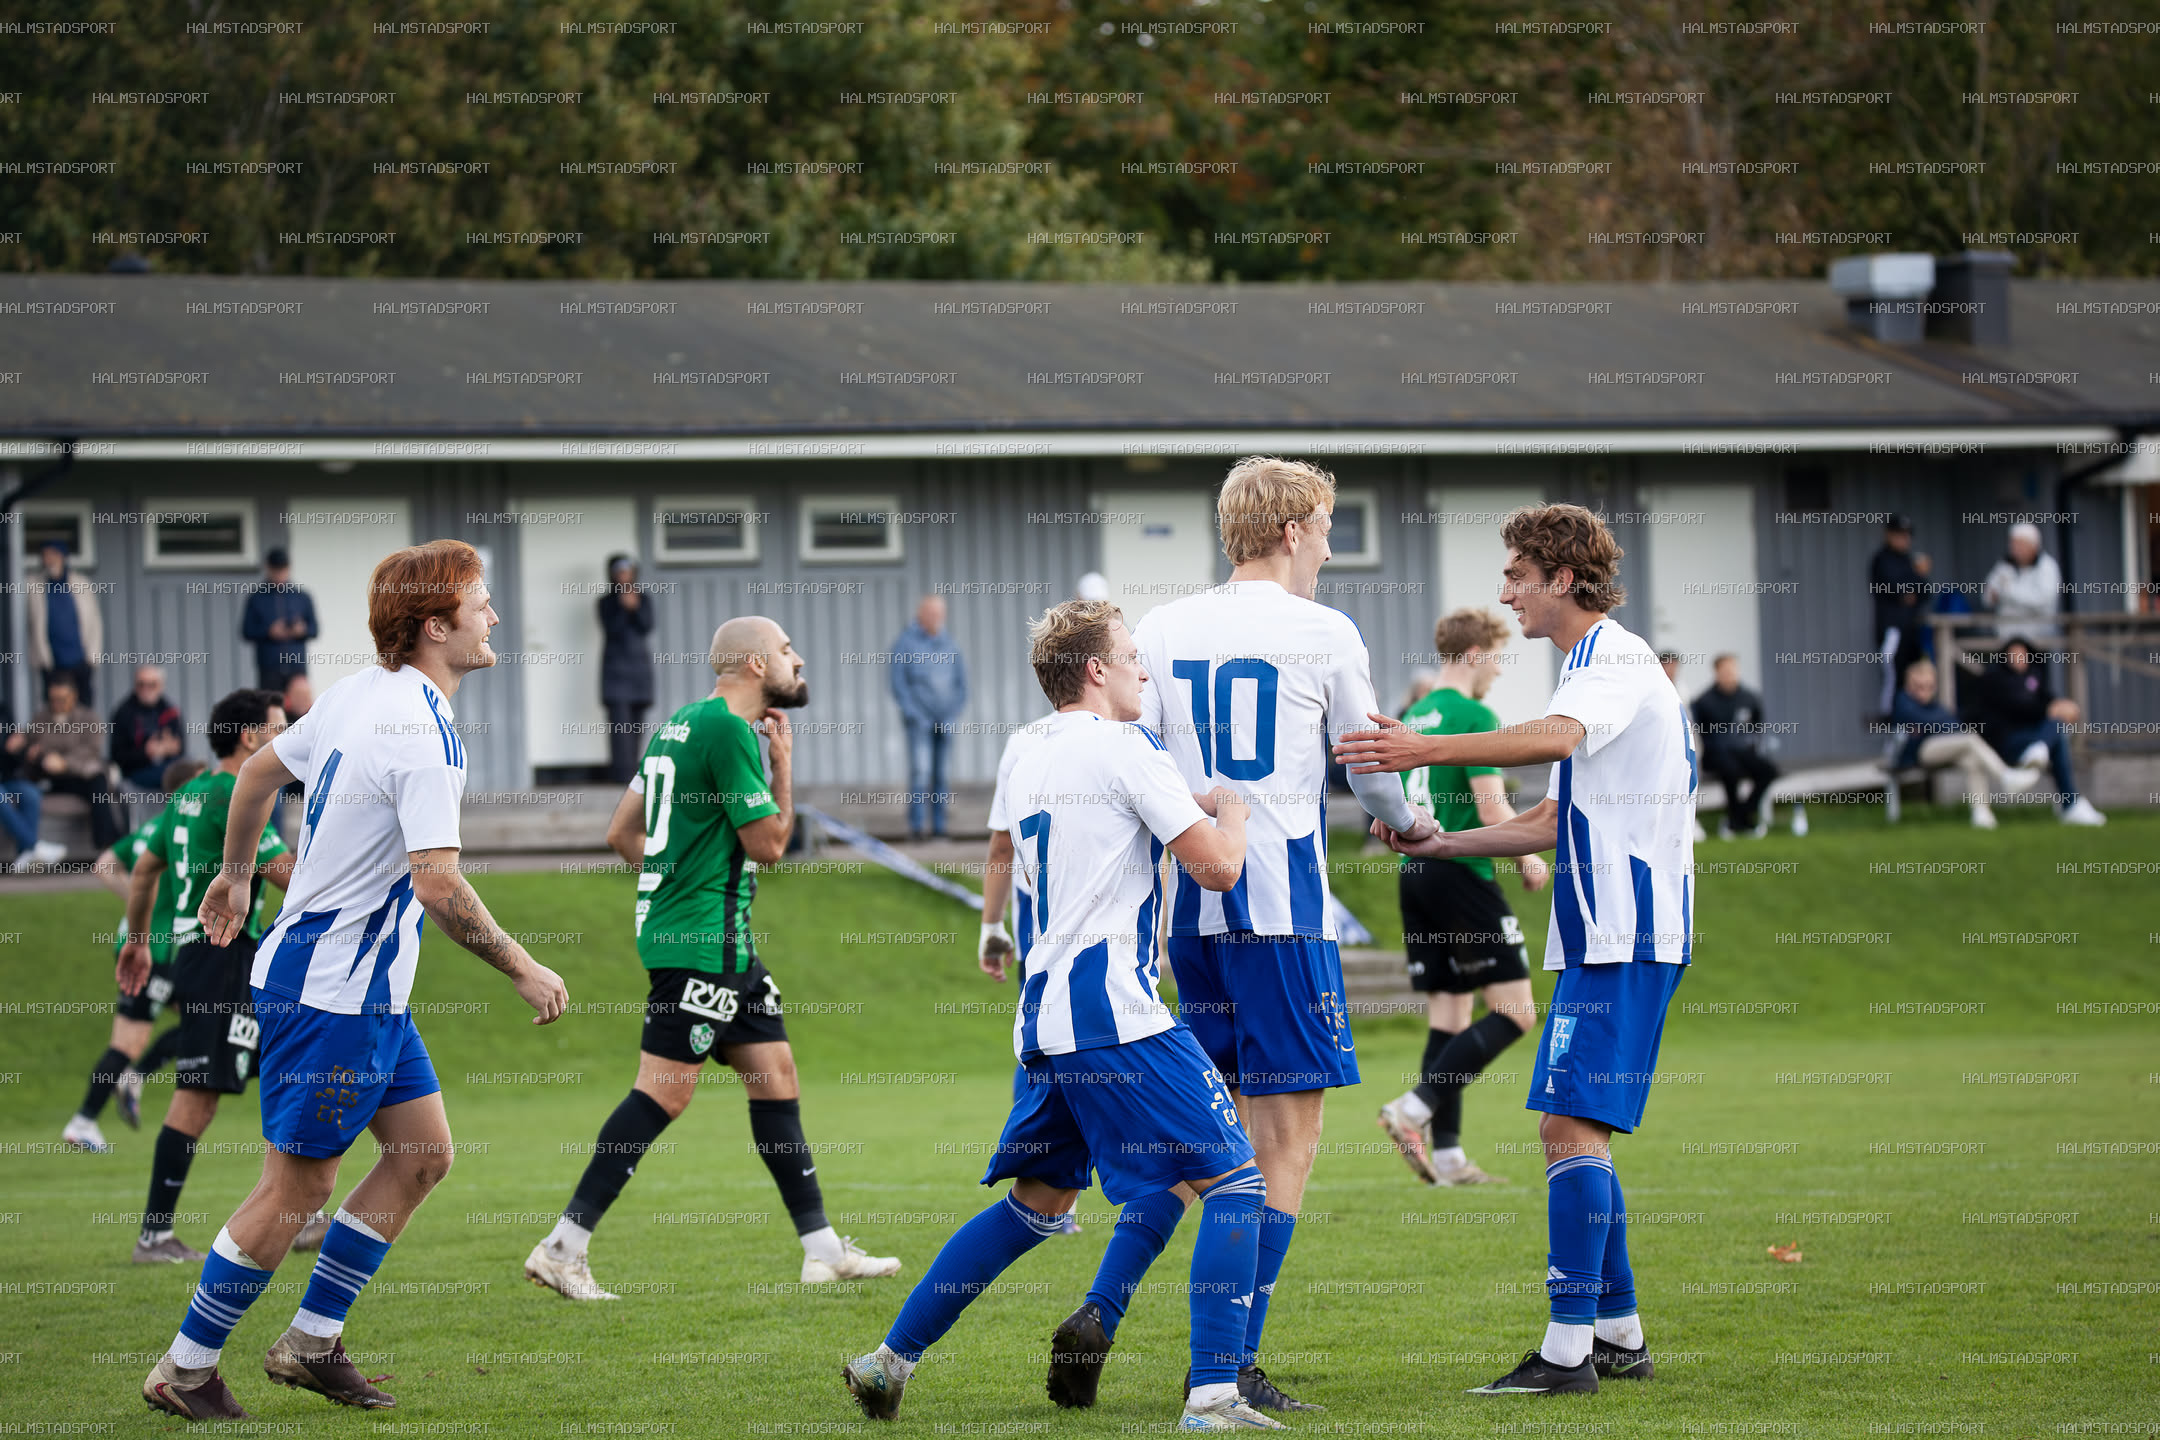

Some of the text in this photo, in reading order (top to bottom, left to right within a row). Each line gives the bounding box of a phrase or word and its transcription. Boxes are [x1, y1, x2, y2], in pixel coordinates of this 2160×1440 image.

[1172, 658, 1279, 781] 10
[303, 748, 343, 863] 4
[1019, 809, 1051, 935] 7
